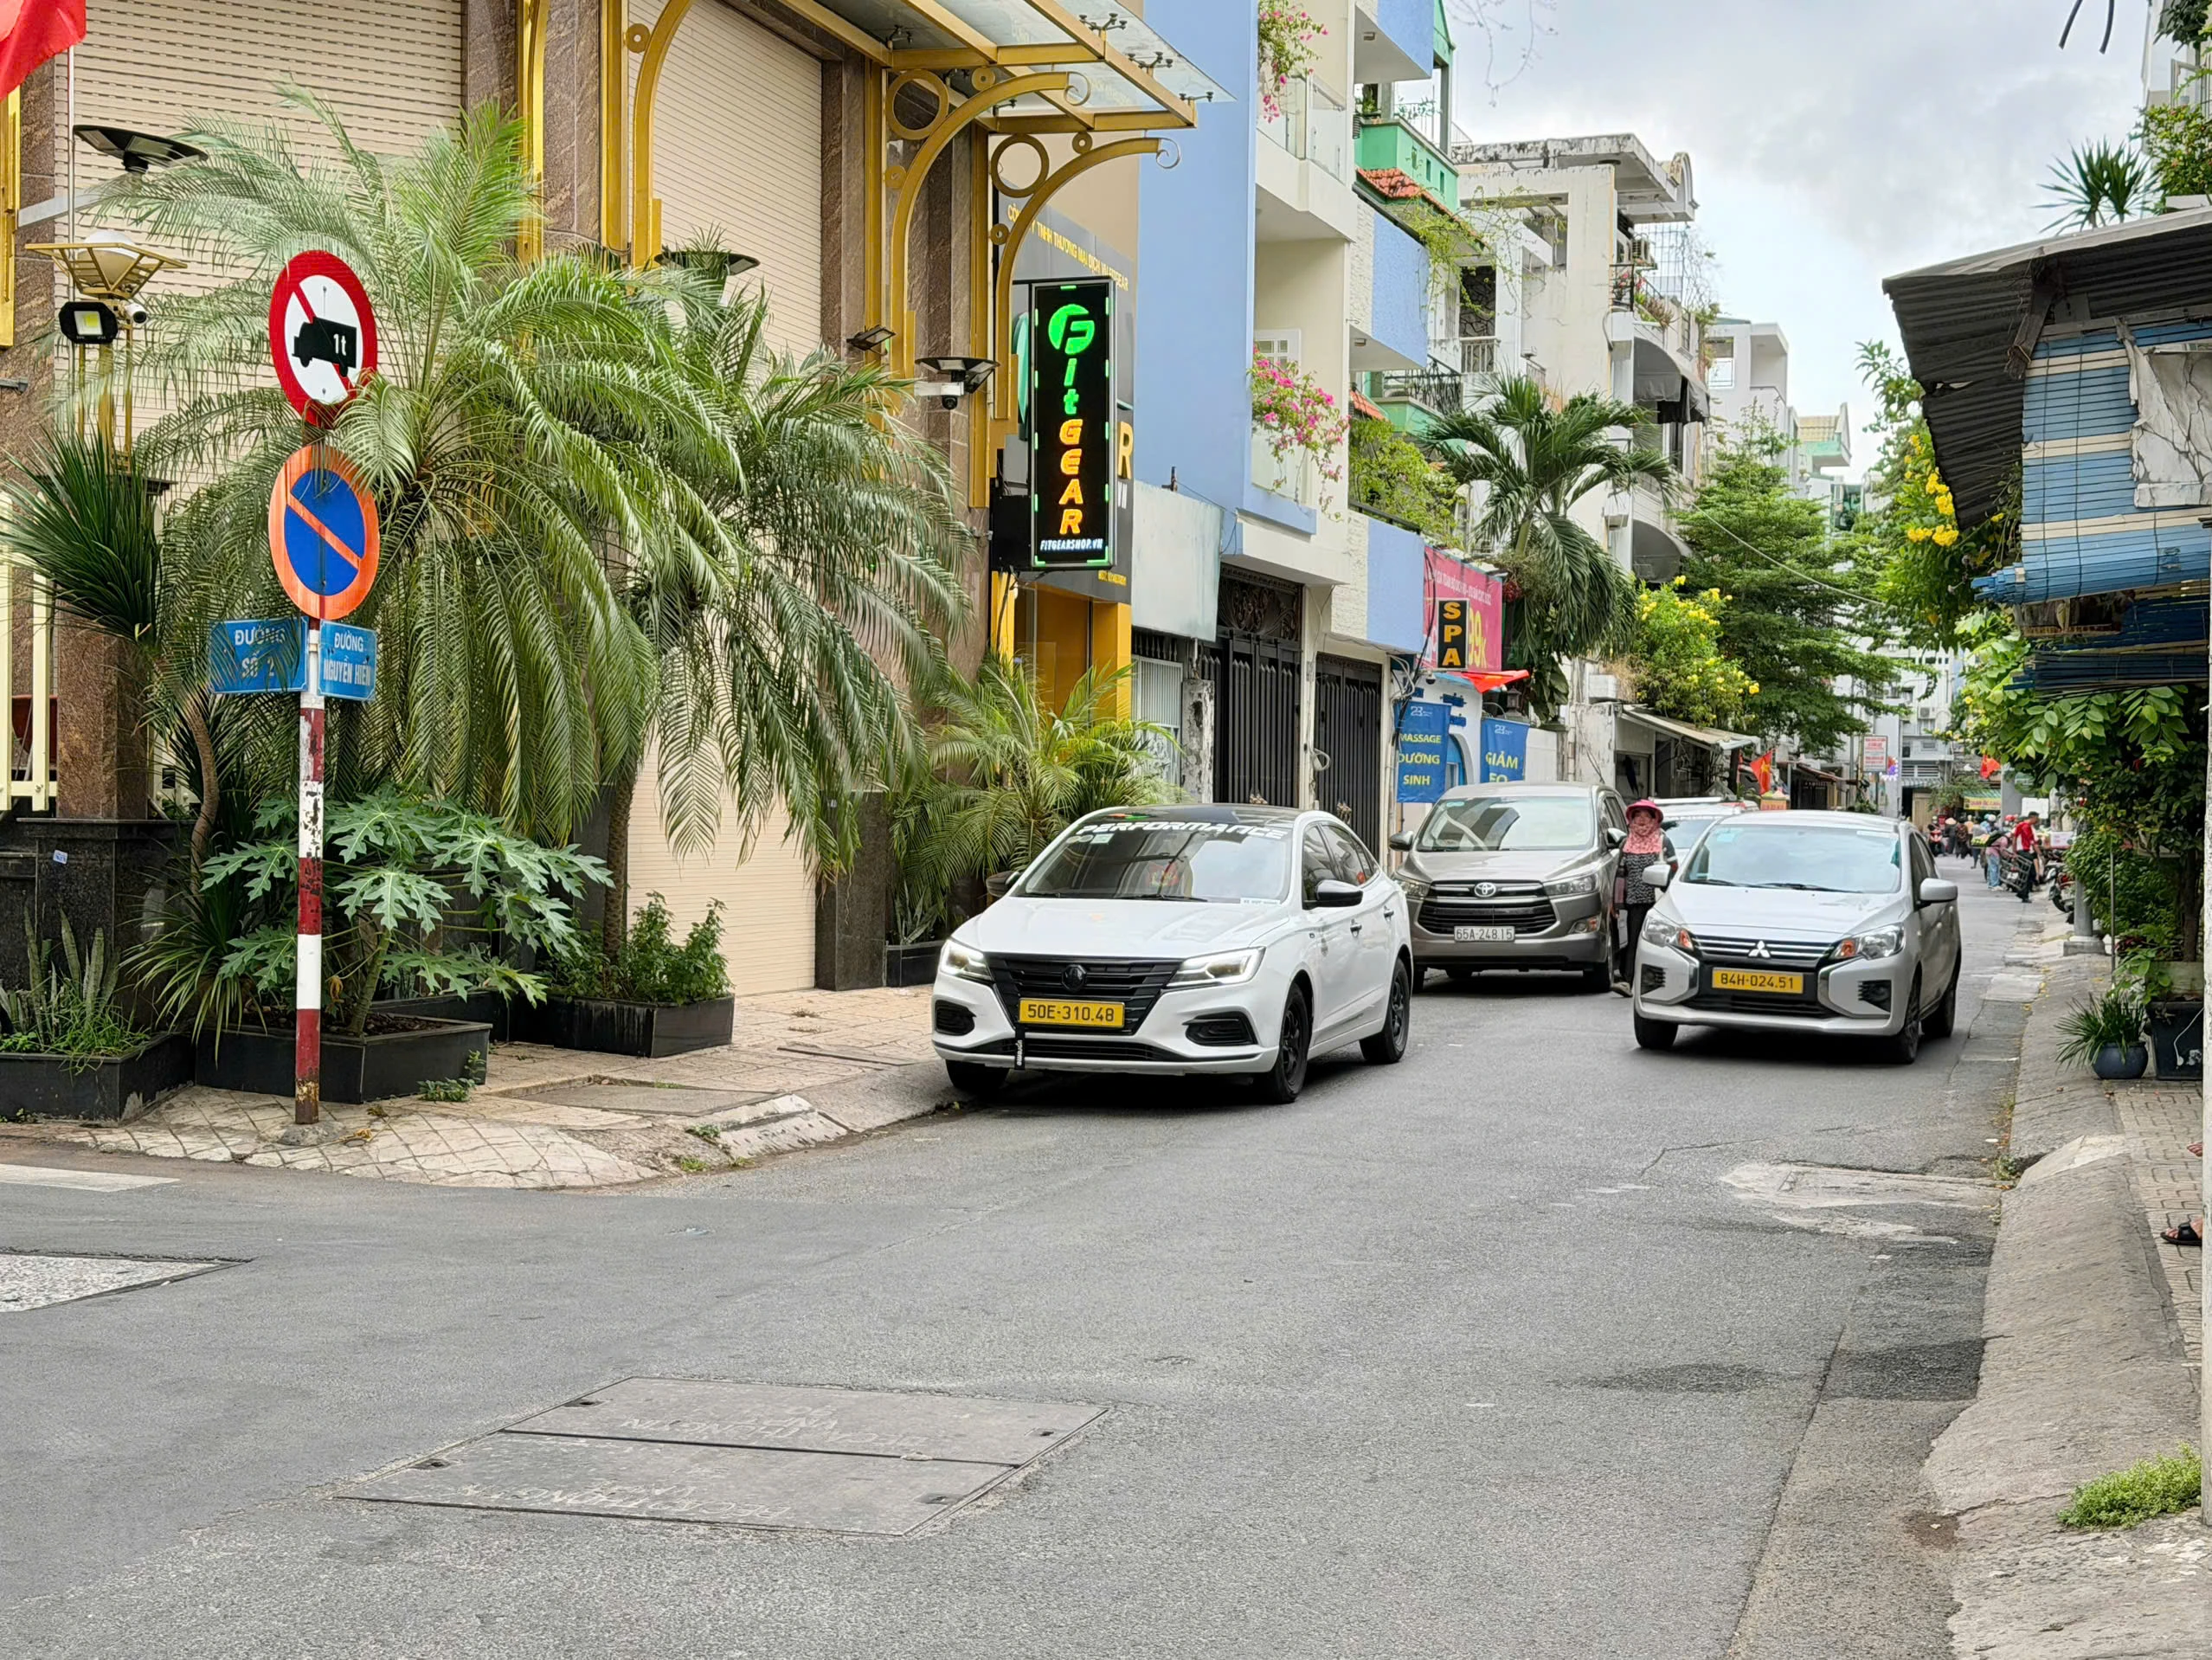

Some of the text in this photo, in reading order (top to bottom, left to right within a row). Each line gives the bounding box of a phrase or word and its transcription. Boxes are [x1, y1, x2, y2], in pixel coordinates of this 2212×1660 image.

[333, 333, 347, 356] 1t
[1039, 537, 1104, 551] FITGEARSHOP.VN
[334, 629, 364, 653] ĐƯỜNG
[1442, 601, 1463, 666] SPA
[1399, 733, 1442, 744] MASSAGE
[1399, 751, 1441, 766] DƯỠNG
[1485, 750, 1520, 769] GIẢM
[1402, 774, 1431, 786] SINH
[1076, 820, 1289, 840] PERFORMANCE
[1720, 972, 1794, 989] 84H-024.51
[1026, 1003, 1116, 1022] 50E-310.48
